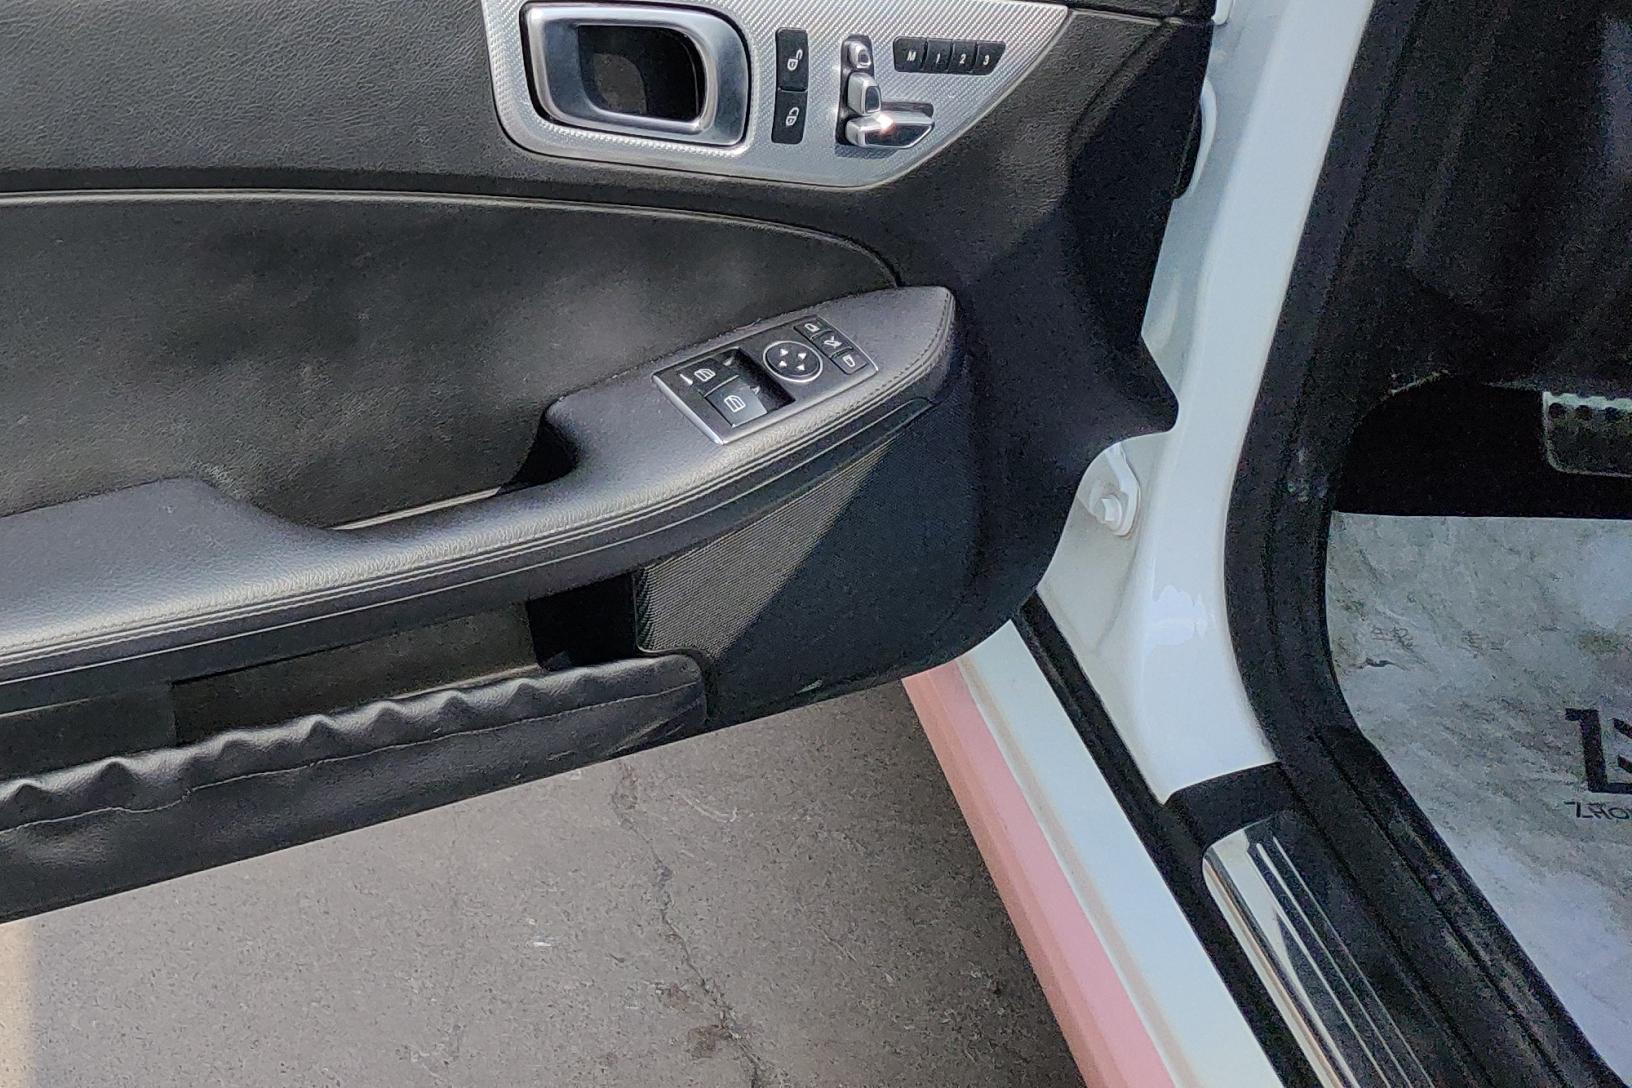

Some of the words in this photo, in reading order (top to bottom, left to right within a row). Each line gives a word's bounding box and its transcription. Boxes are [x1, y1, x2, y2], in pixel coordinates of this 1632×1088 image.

[907, 50, 917, 61] M
[935, 53, 941, 64] 1
[959, 53, 967, 65] 2
[983, 55, 990, 66] 3
